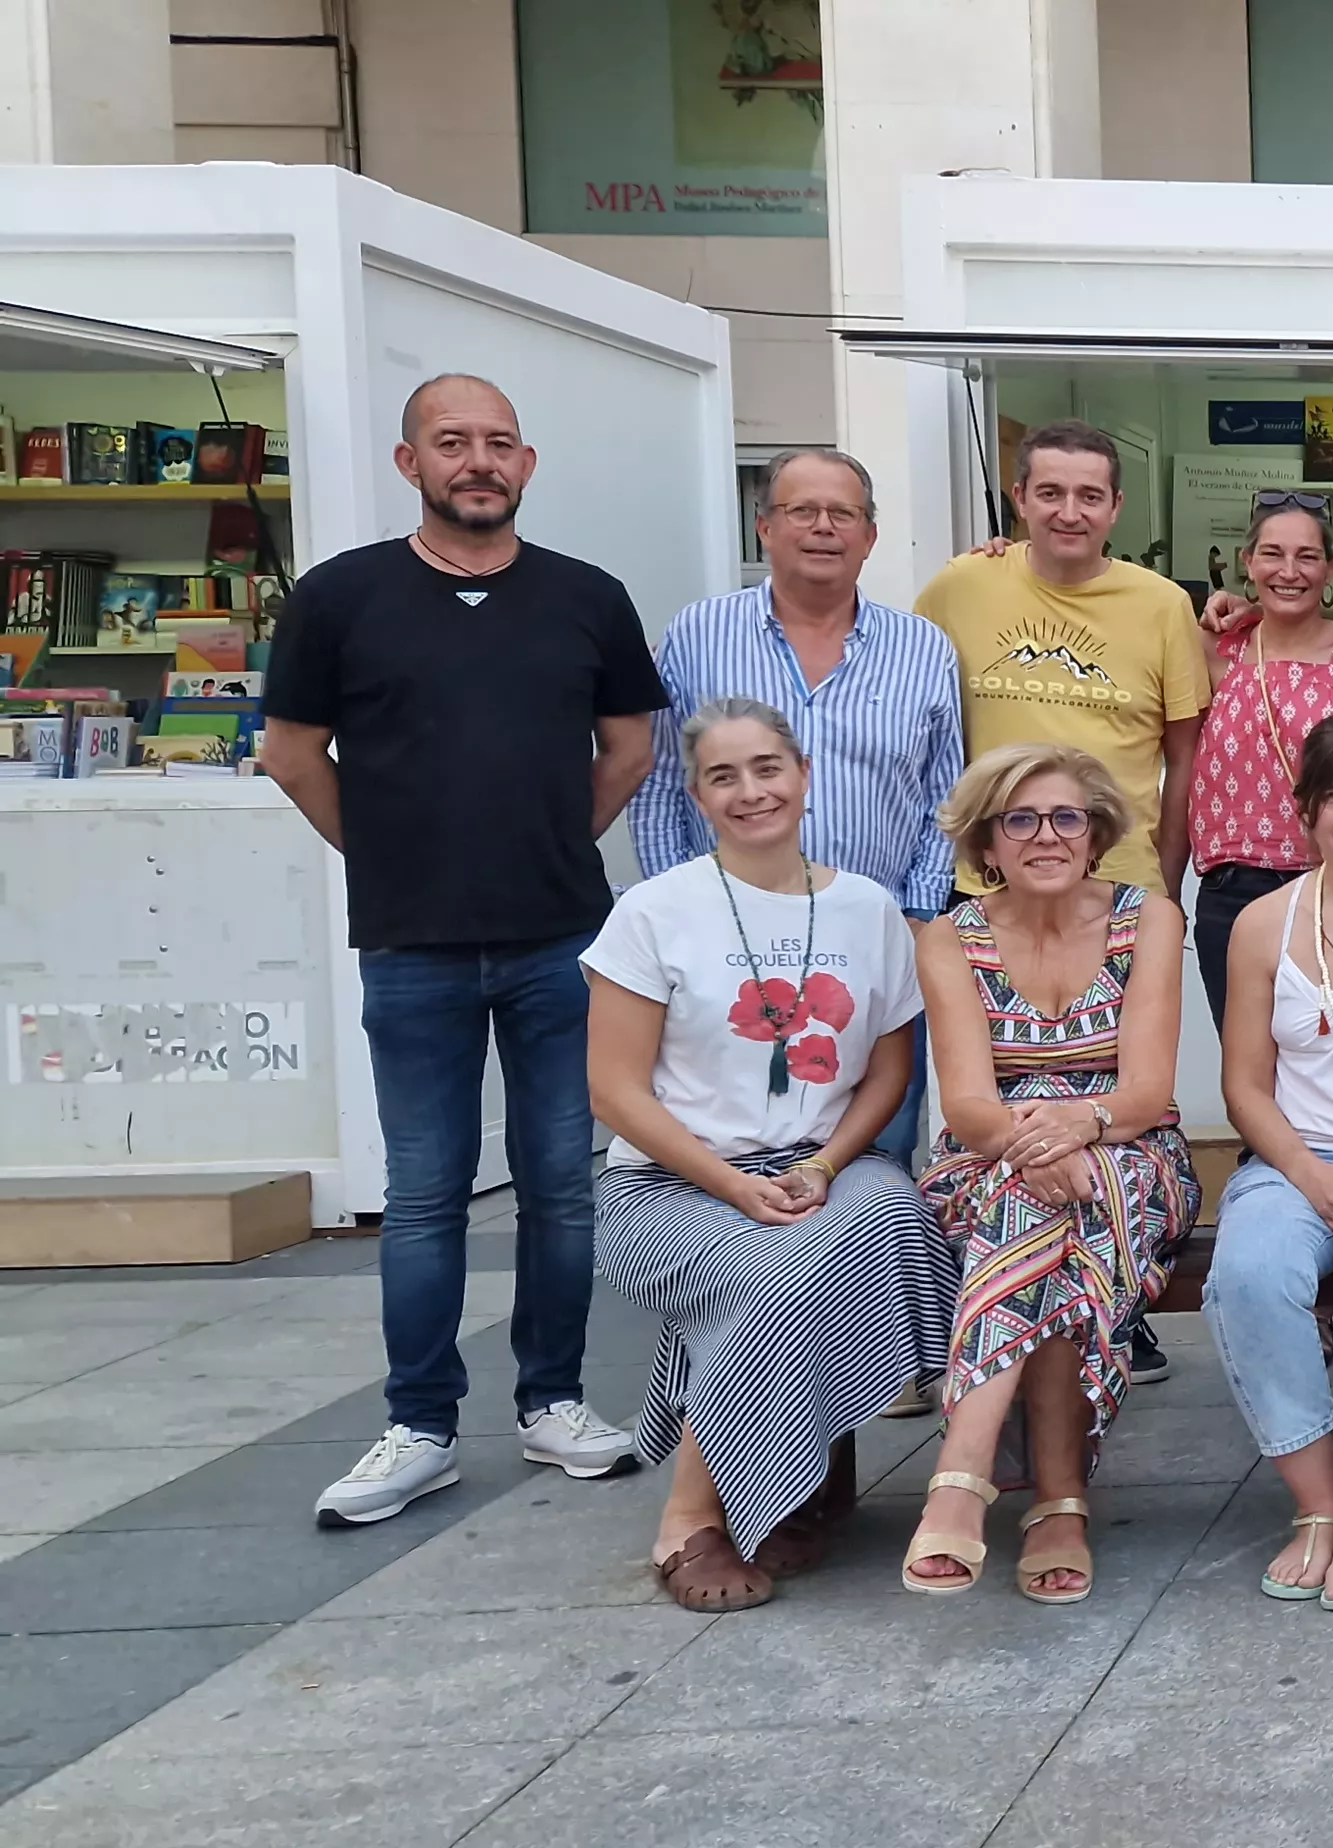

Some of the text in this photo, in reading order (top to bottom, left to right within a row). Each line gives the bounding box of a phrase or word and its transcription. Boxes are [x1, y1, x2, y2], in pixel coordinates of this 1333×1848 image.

[584, 181, 667, 213] MPA
[1224, 468, 1258, 478] Muñoz
[1261, 469, 1296, 481] Molina
[968, 676, 1133, 703] COLORADO
[975, 692, 1120, 712] MOUNTAIN EXPLORATION
[770, 938, 802, 952] LES
[725, 953, 848, 967] COQUELICOTS
